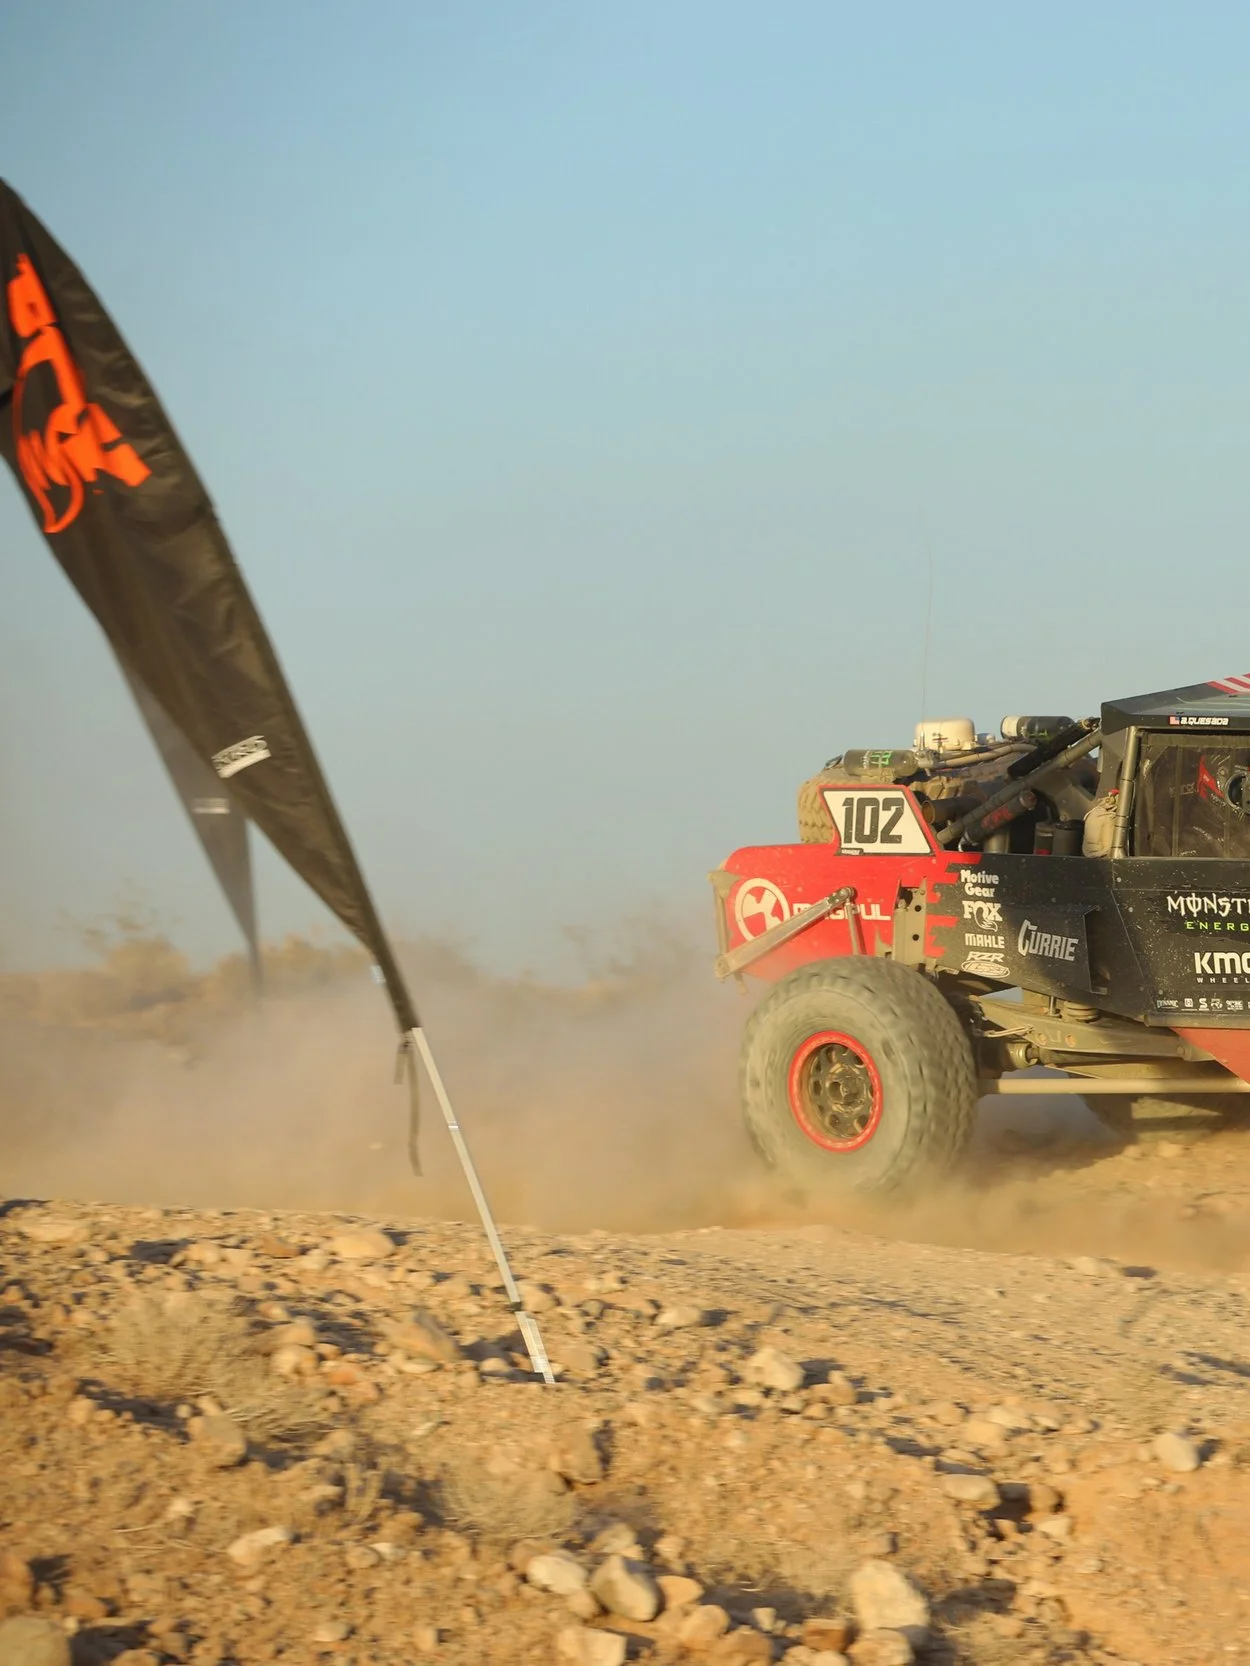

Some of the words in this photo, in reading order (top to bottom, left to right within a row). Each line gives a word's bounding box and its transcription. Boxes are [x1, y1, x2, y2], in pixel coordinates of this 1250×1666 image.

[842, 797, 905, 844] 102
[960, 869, 999, 884] Motive
[964, 883, 995, 897] Gear
[964, 933, 1005, 949] MAHLE
[1017, 919, 1079, 961] CURRIE
